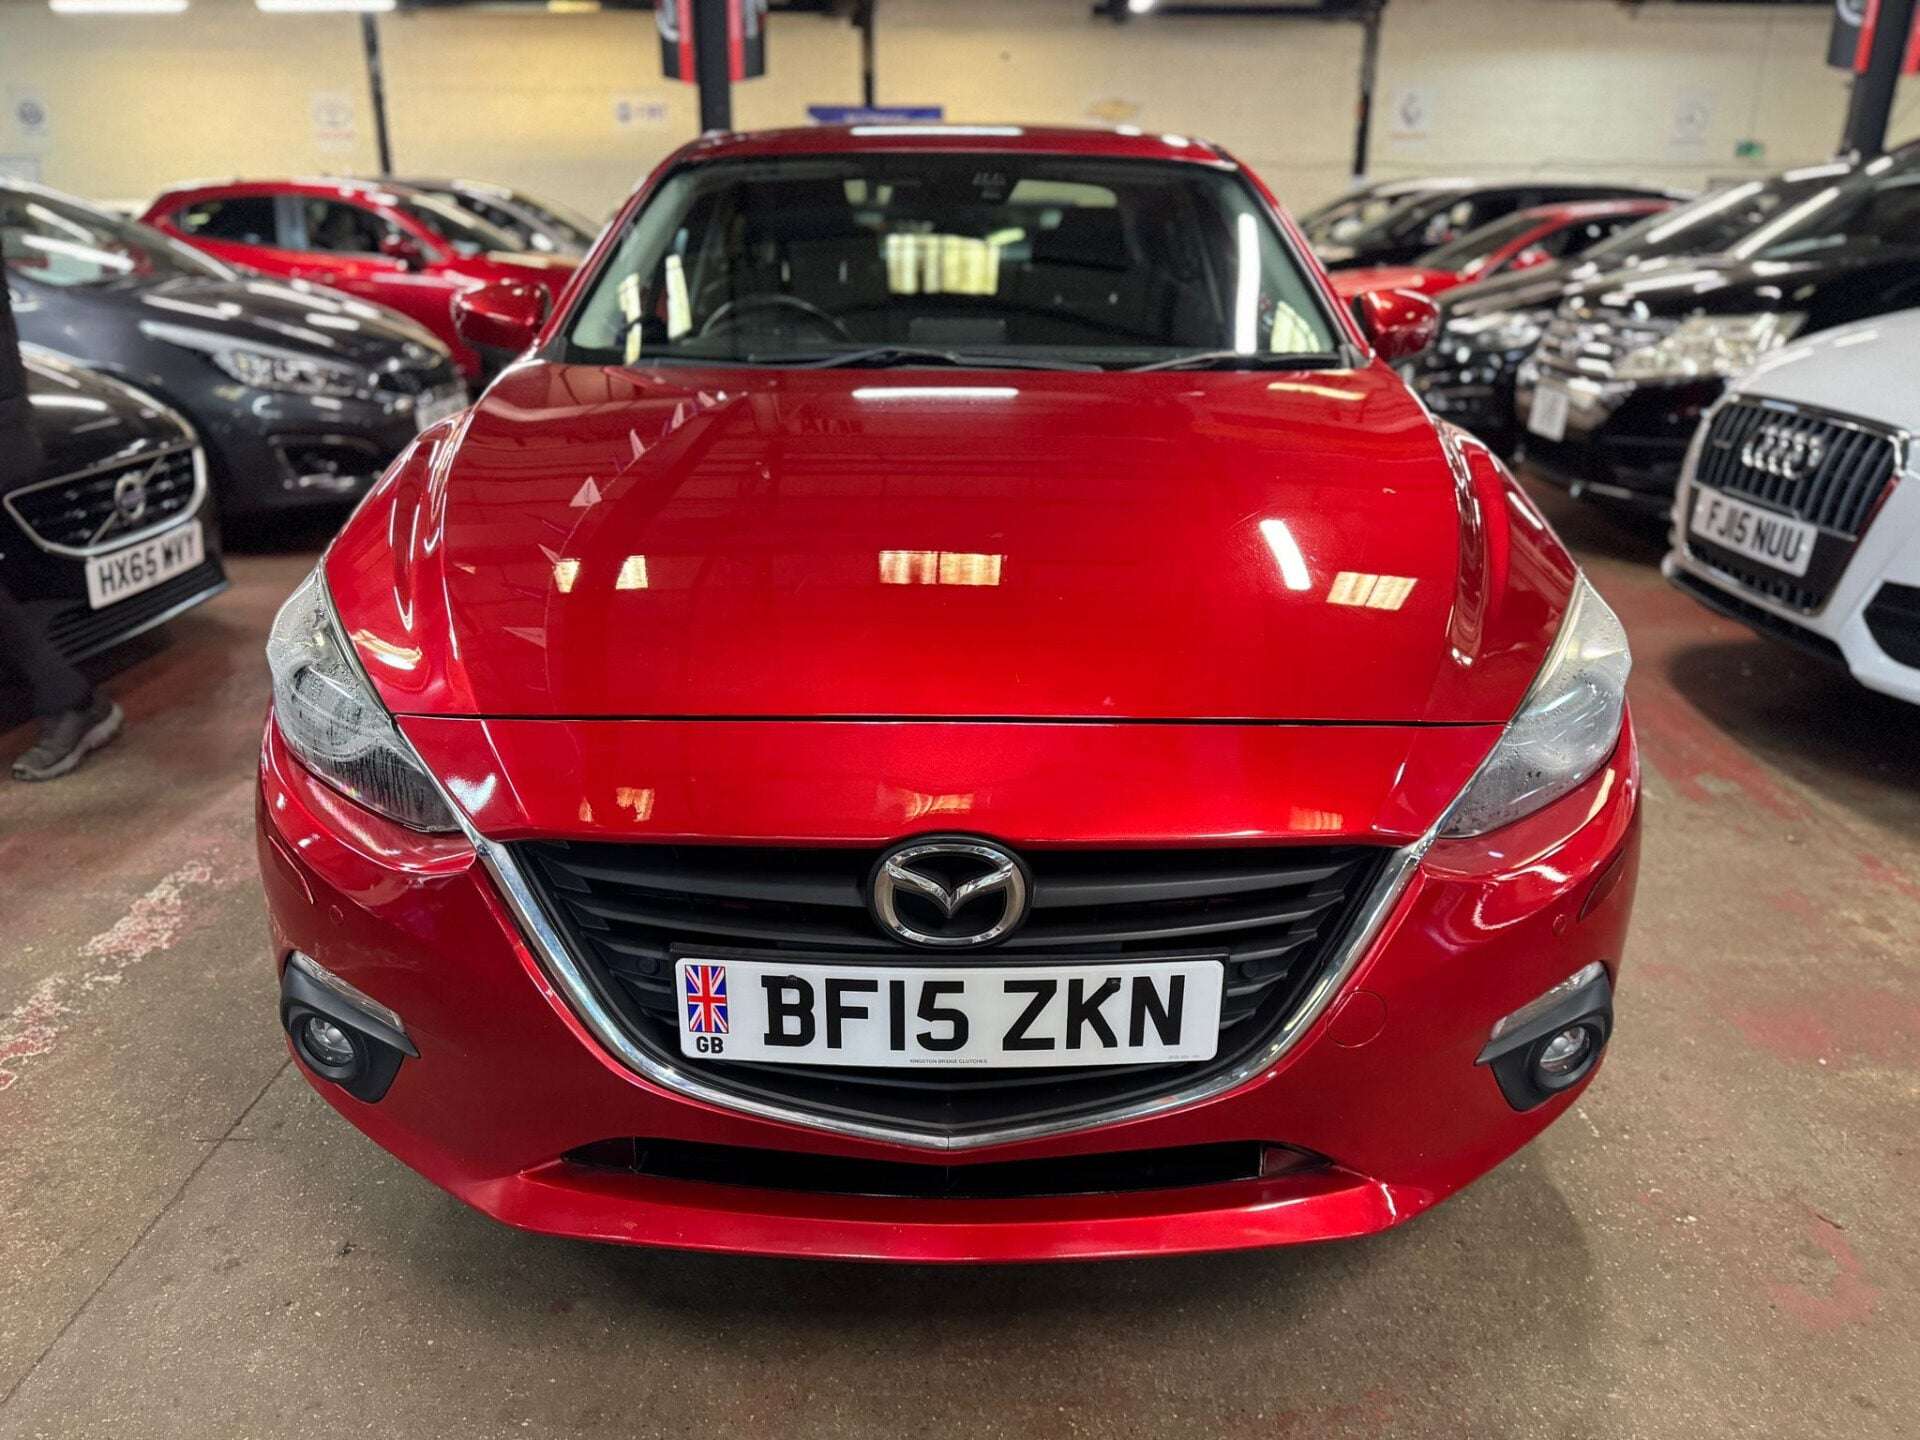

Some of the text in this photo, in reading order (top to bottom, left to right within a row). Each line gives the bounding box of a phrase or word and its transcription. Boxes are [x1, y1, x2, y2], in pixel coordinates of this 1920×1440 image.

[1751, 519, 1804, 563] NUU
[98, 546, 157, 596] HX65
[761, 974, 1187, 1052] BF15 ZKN
[696, 1036, 724, 1054] GB
